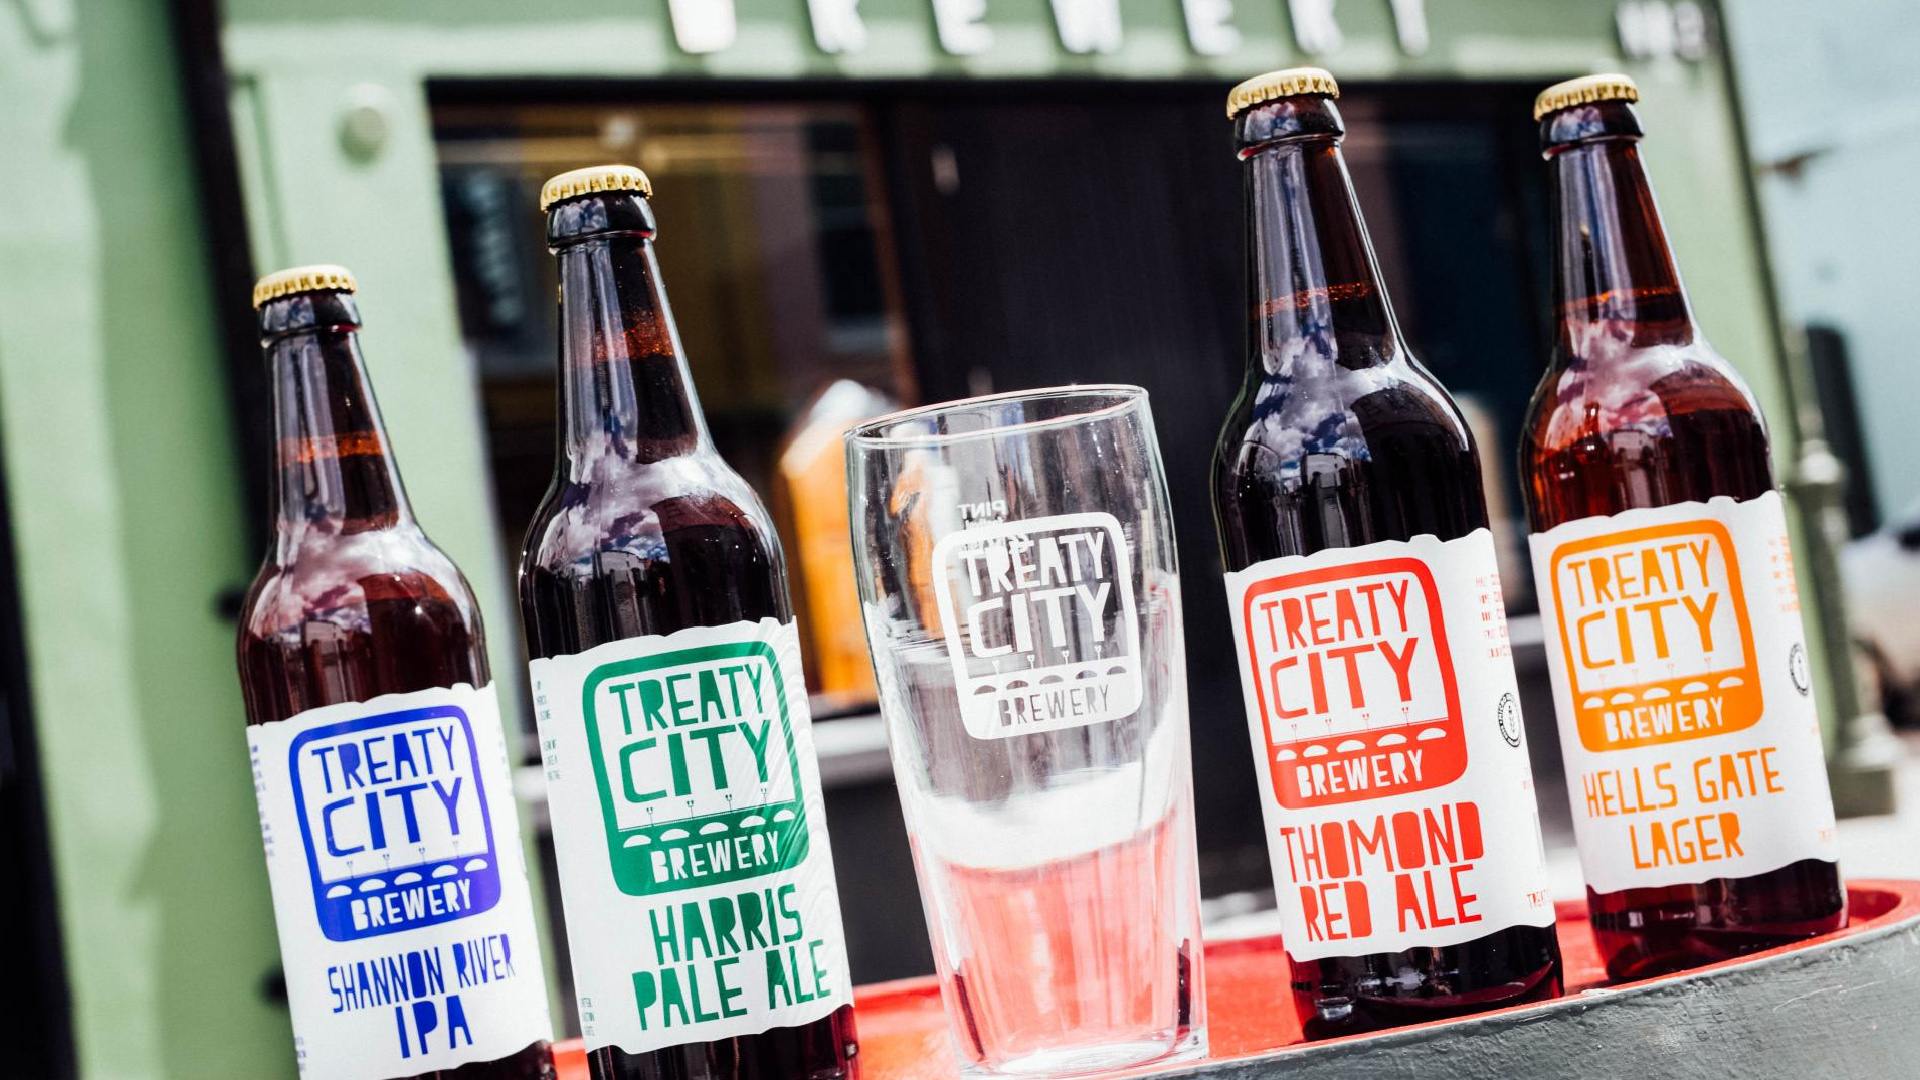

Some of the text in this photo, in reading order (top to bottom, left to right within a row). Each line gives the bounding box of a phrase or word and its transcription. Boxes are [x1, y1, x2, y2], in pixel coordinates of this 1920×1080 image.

[958, 532, 1105, 596] TREATY
[1567, 537, 1711, 607] TREATY
[967, 582, 1111, 658] CITY
[1260, 579, 1408, 652] TREATY
[1576, 592, 1719, 670] CITY
[609, 664, 763, 735] TREATY
[999, 684, 1109, 727] BREWERY
[1270, 637, 1419, 719] CITY
[1604, 698, 1722, 742] BREWERY
[311, 726, 454, 793] TREATY
[619, 720, 770, 803] CITY
[1296, 750, 1422, 798] BREWERY
[1582, 762, 1678, 817] HELLS
[1693, 747, 1785, 804] GATE
[323, 777, 461, 857] CITY
[1280, 802, 1484, 883] THOMOND
[1629, 812, 1744, 870] LAGER
[650, 831, 778, 883] BREWERY
[351, 879, 470, 930] BREWERY
[649, 884, 803, 965] HARRIS
[1300, 864, 1482, 942] RED ALE
[328, 934, 516, 1013] SHANNON RIVER
[632, 957, 747, 1031] PALE
[766, 941, 831, 1009] ALE
[395, 995, 473, 1059] IPA
